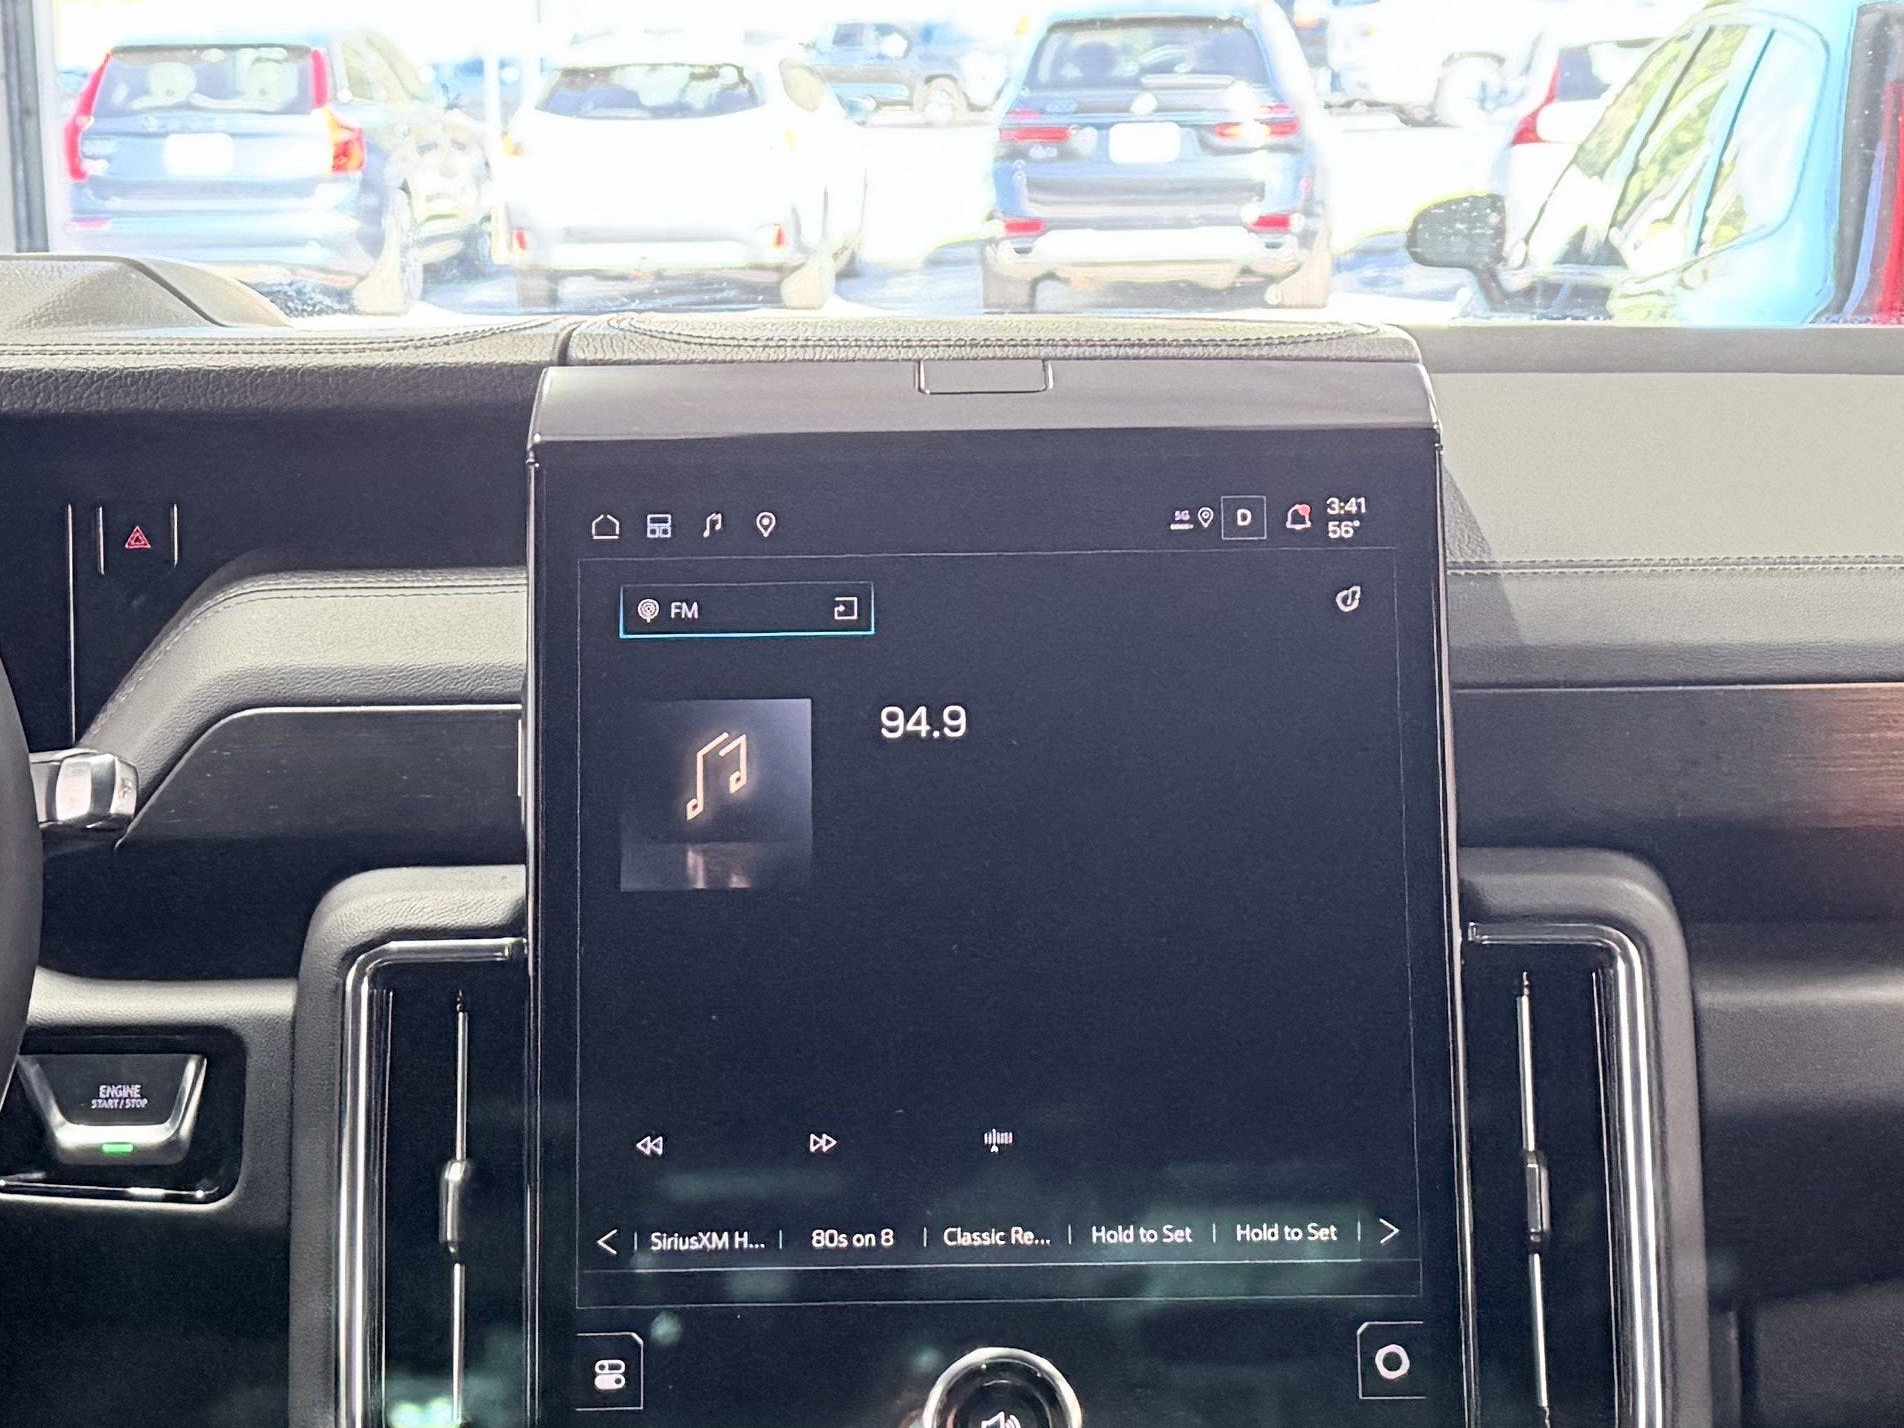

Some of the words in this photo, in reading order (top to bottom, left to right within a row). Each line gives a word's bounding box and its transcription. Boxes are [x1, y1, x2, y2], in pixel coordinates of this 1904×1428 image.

[1326, 497, 1367, 515] 3:41
[1236, 508, 1252, 526] D
[1327, 520, 1360, 539] 56°
[670, 602, 699, 619] FM
[880, 705, 967, 738] 94.9
[99, 1084, 141, 1098] ENGINE
[650, 1231, 729, 1251] SiriusXM
[734, 1230, 766, 1251] H...
[811, 1228, 849, 1249] 80s
[852, 1234, 876, 1247] on
[880, 1228, 895, 1247] 8
[943, 1226, 1006, 1247] Classic
[1010, 1226, 1051, 1246] Re...
[1091, 1224, 1135, 1244] Hold
[1139, 1227, 1158, 1243] to
[1162, 1224, 1193, 1243] Set
[1236, 1222, 1280, 1242] Hold
[1283, 1225, 1302, 1241] to
[1306, 1222, 1338, 1242] Set
